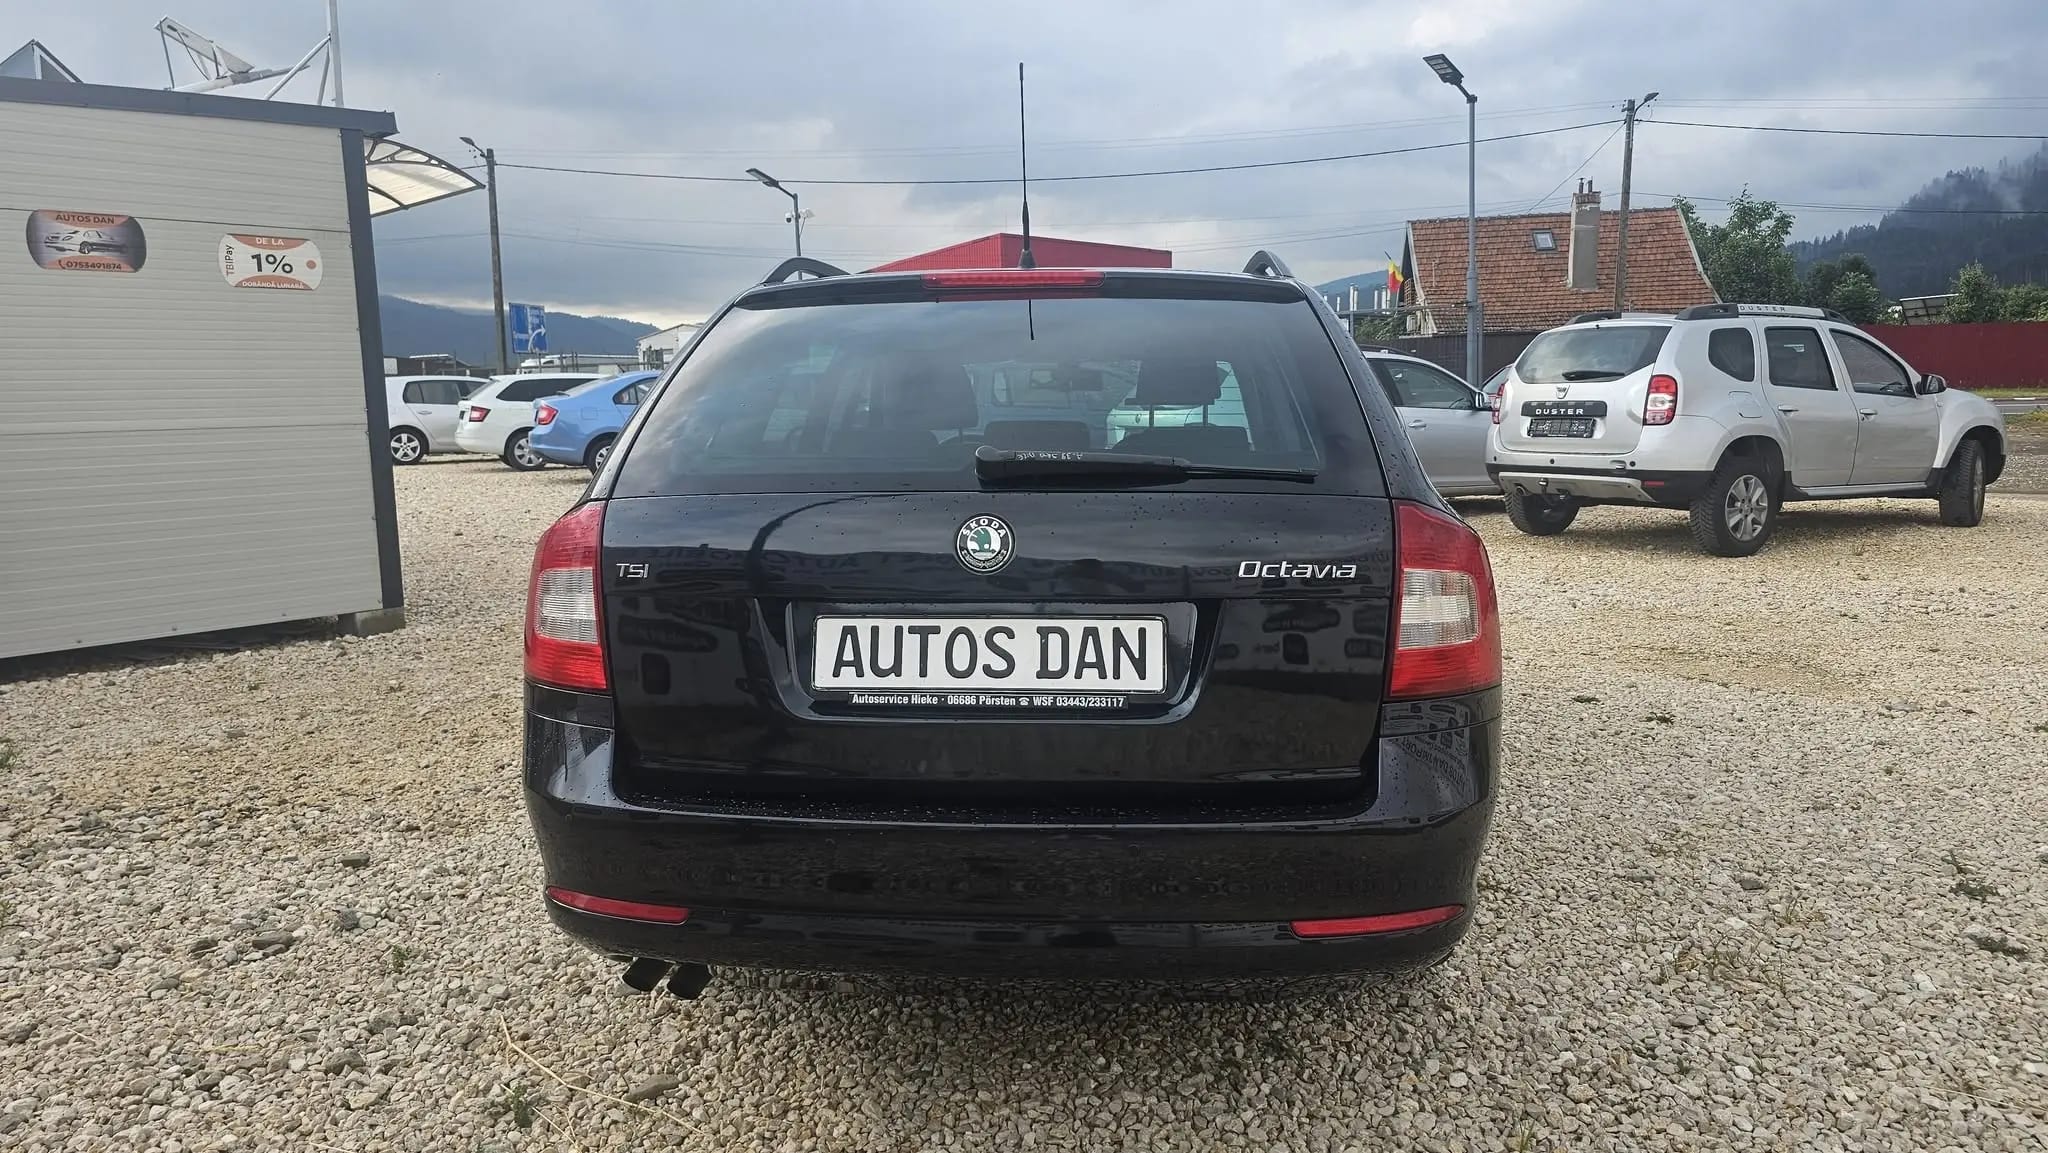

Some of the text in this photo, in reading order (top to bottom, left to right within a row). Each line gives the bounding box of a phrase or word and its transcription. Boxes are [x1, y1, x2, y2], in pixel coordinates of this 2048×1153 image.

[55, 214, 115, 225] AUTOS DAN
[255, 237, 285, 246] DE LA
[66, 260, 122, 270] 0753491874
[224, 244, 235, 276] TBIPay
[251, 253, 293, 274] 1%
[615, 563, 649, 578] TSI
[1238, 560, 1357, 579] Octavia
[831, 625, 1147, 681] AUTOS DAN
[852, 694, 1124, 707] Autoservice Hieke 06686 Pörsten WSF 03443/233117
